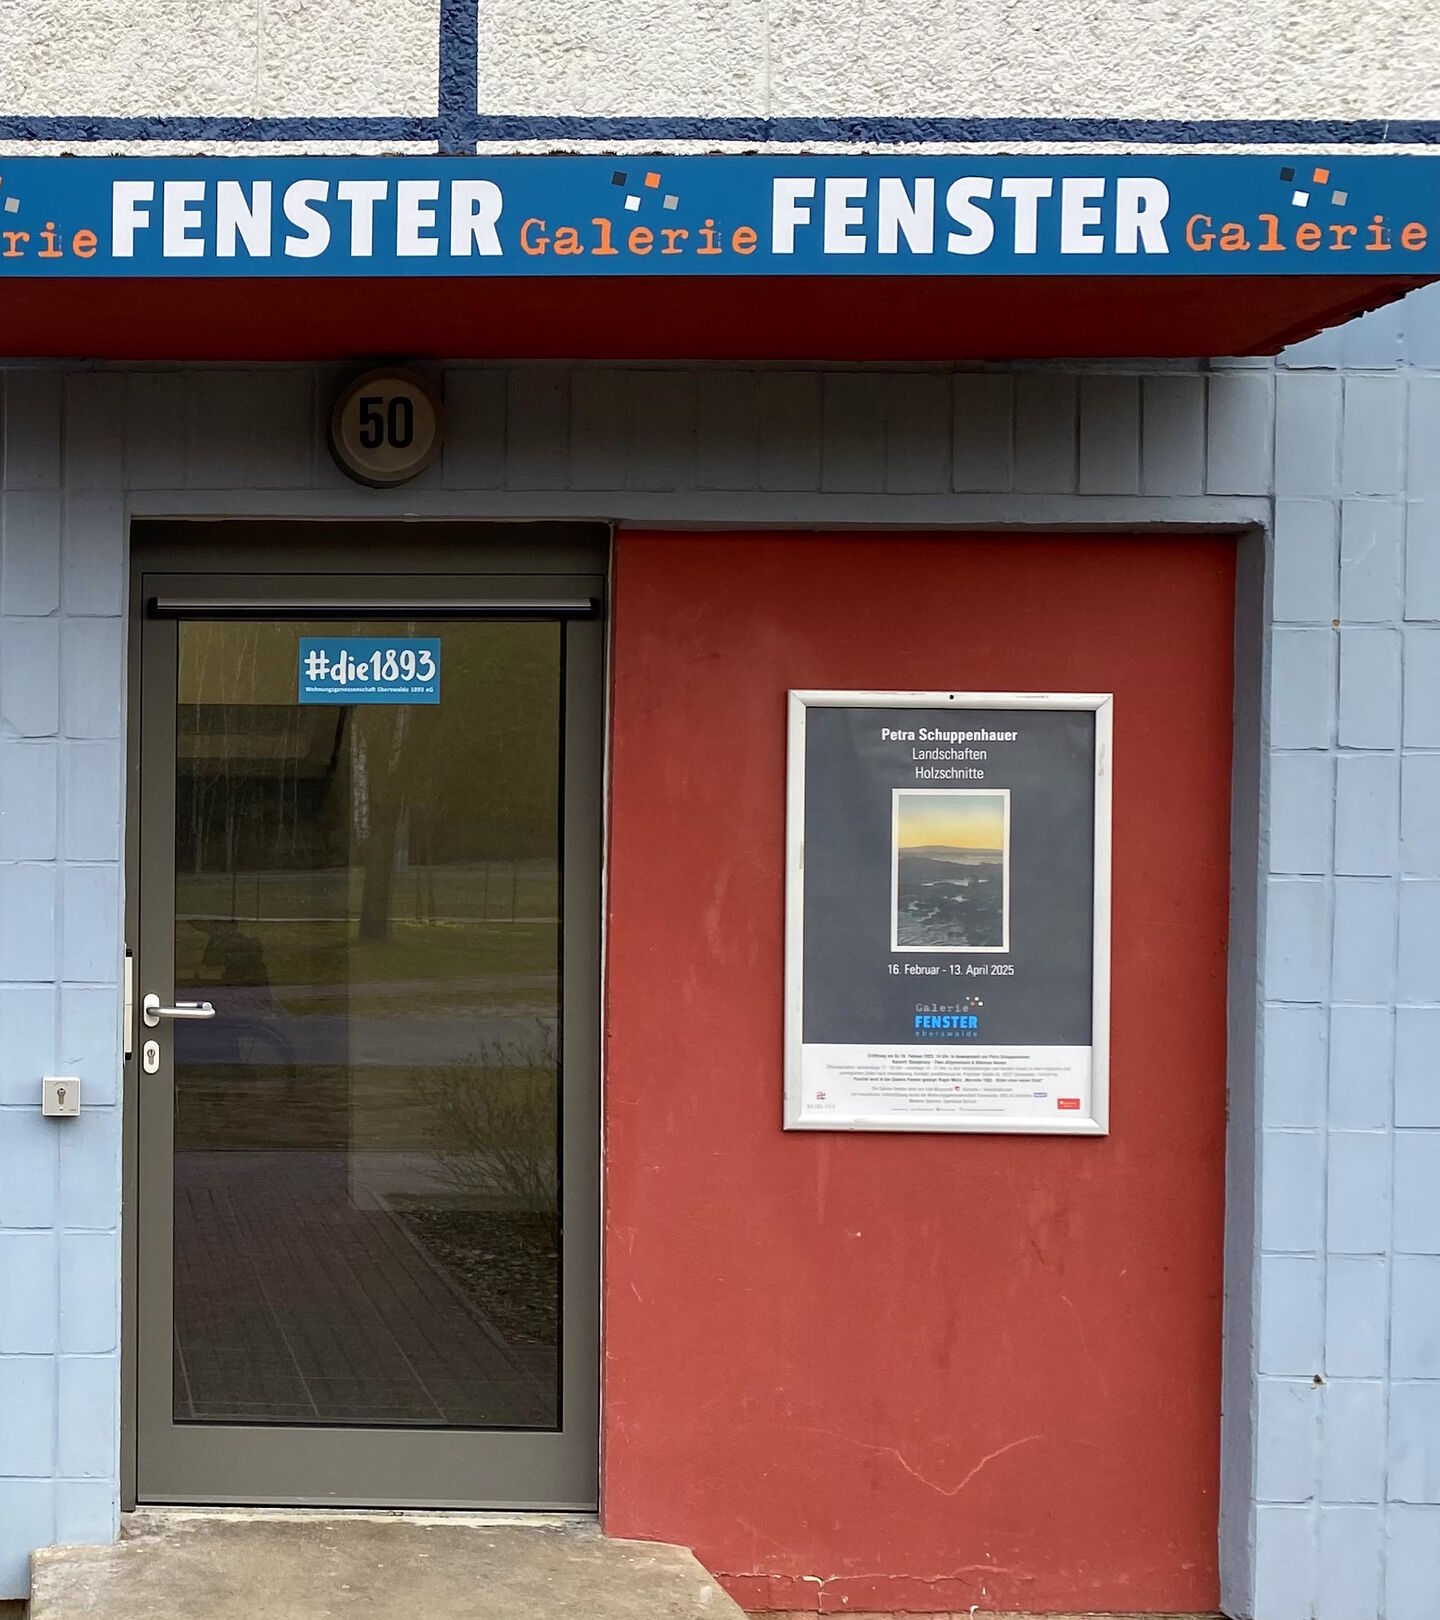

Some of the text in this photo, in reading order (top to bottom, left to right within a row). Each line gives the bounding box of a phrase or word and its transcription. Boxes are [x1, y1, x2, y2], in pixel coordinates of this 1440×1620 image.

[111, 179, 504, 259] FENSTER
[519, 217, 759, 257] Galerie
[771, 176, 1171, 256] FENSTER
[1185, 213, 1428, 252] Galerie
[359, 396, 414, 449] 50
[303, 649, 436, 685] #die1893
[881, 727, 1019, 744] Petra Schuppenhauer
[912, 747, 988, 760] Landschaften
[915, 766, 985, 779] Holzschnitte
[887, 963, 902, 975] 16.
[904, 963, 940, 976] Februar
[949, 963, 964, 976] 13.
[965, 964, 989, 978] April
[990, 964, 1015, 976] 2025
[915, 1003, 969, 1013] Galerie
[915, 1014, 978, 1029] FENSTER
